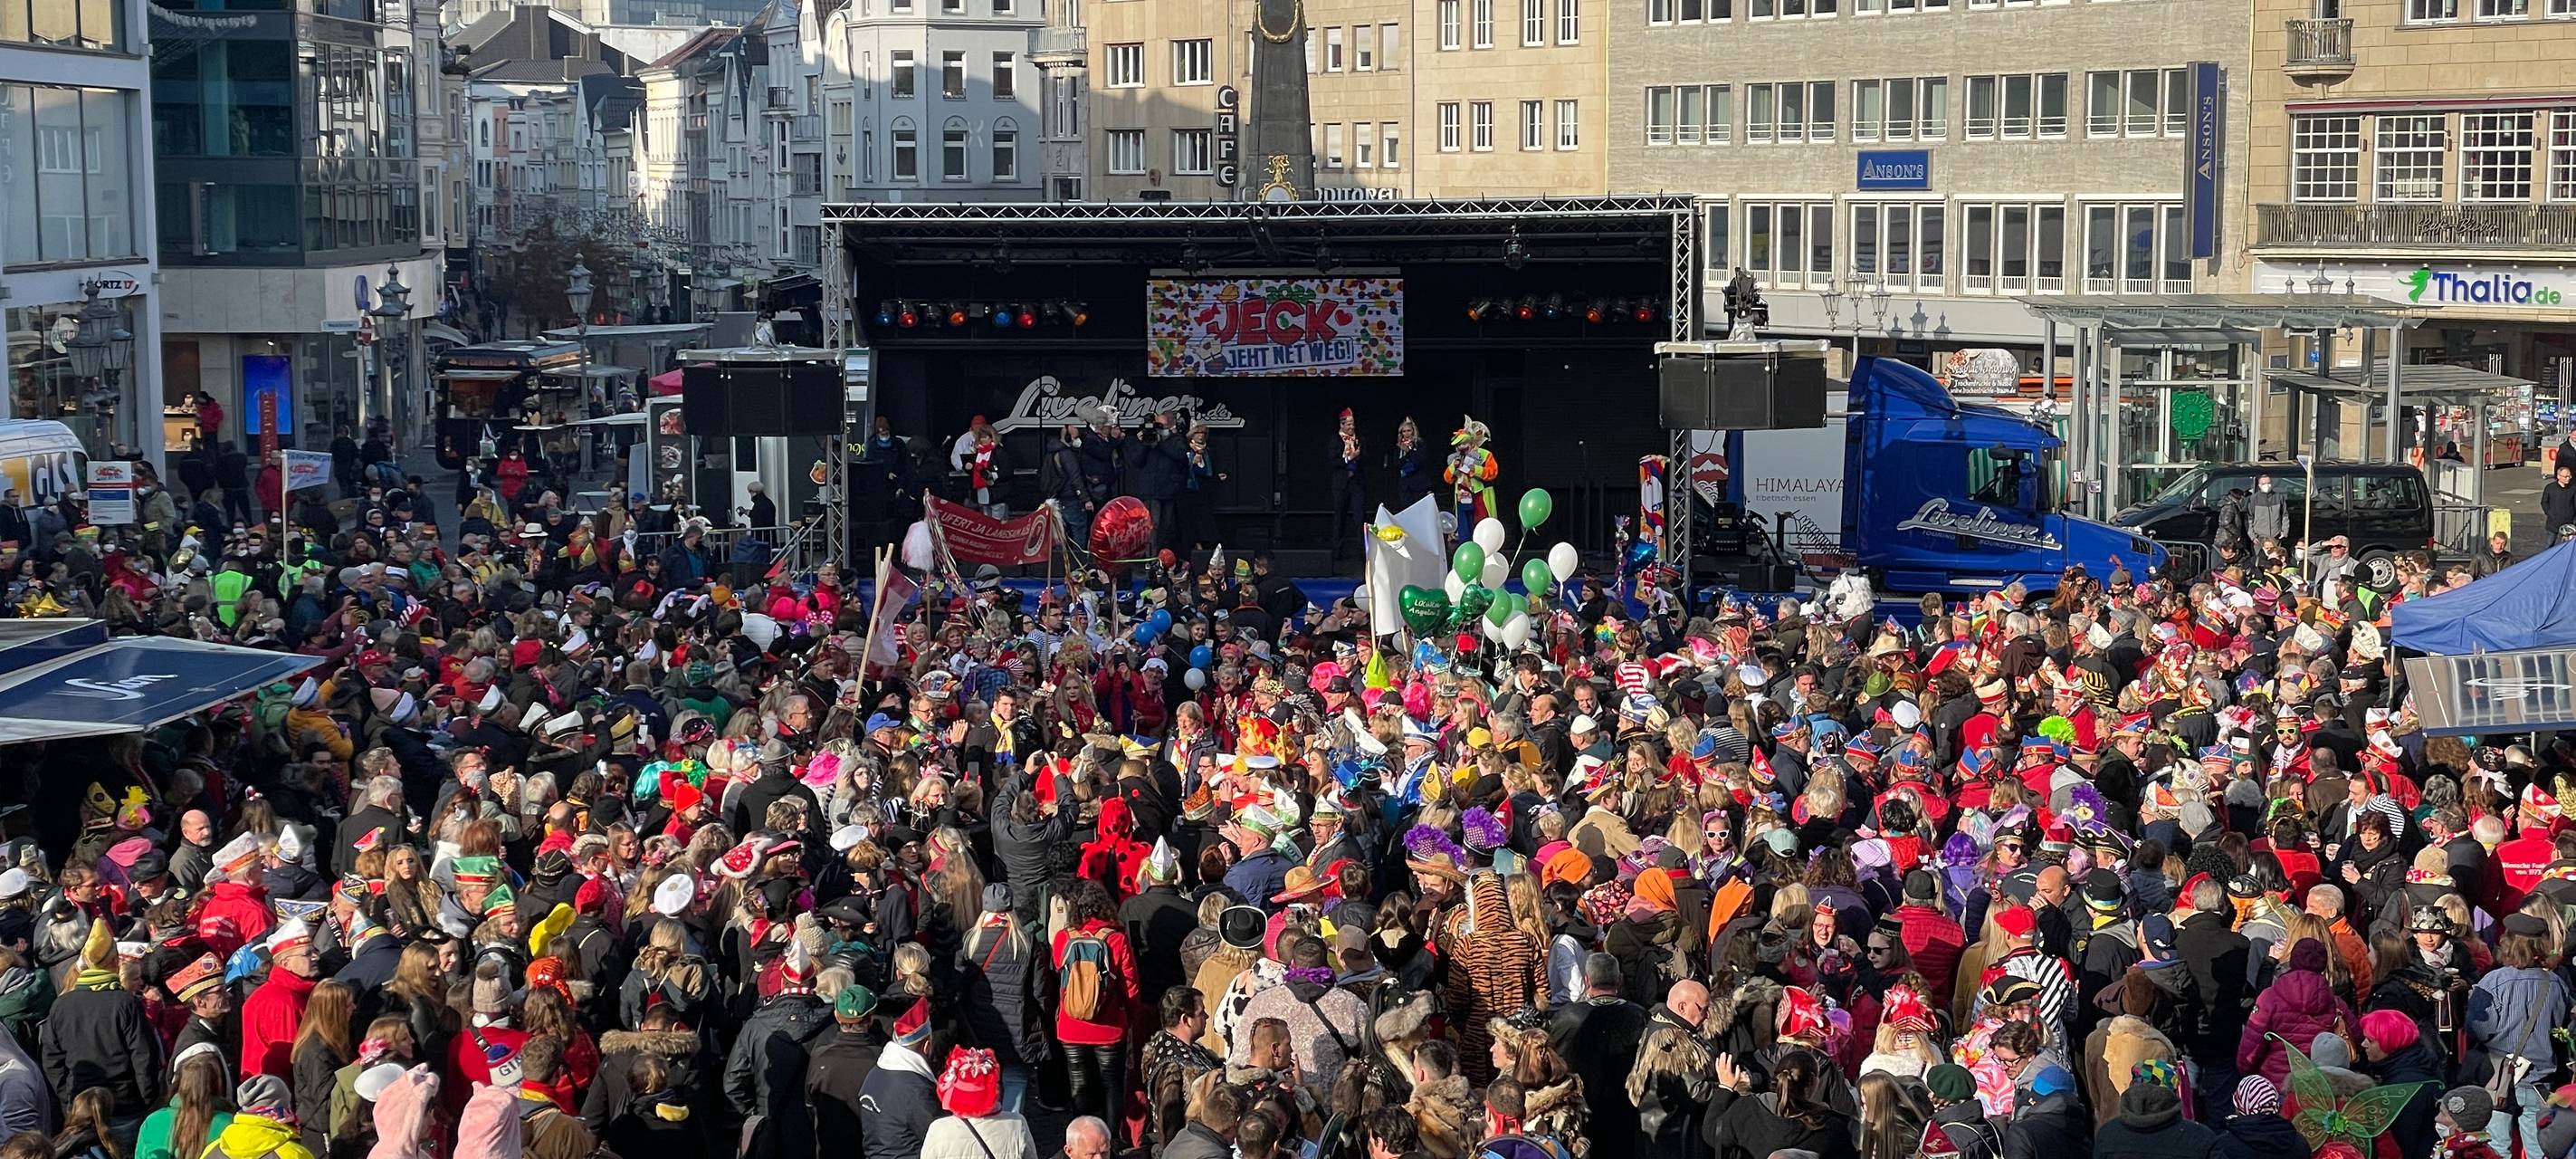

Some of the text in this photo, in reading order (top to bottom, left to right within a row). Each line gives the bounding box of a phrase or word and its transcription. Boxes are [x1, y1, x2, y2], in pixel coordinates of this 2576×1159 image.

[1219, 88, 1235, 185] CAFE
[2198, 96, 2213, 180] ANSON'S
[1862, 158, 1924, 180] ANSON'S
[123, 280, 134, 289] 17
[2432, 272, 2562, 305] Thalia.de
[1207, 299, 1338, 345] JECK
[1227, 339, 1351, 369] JEHT NET WEG!
